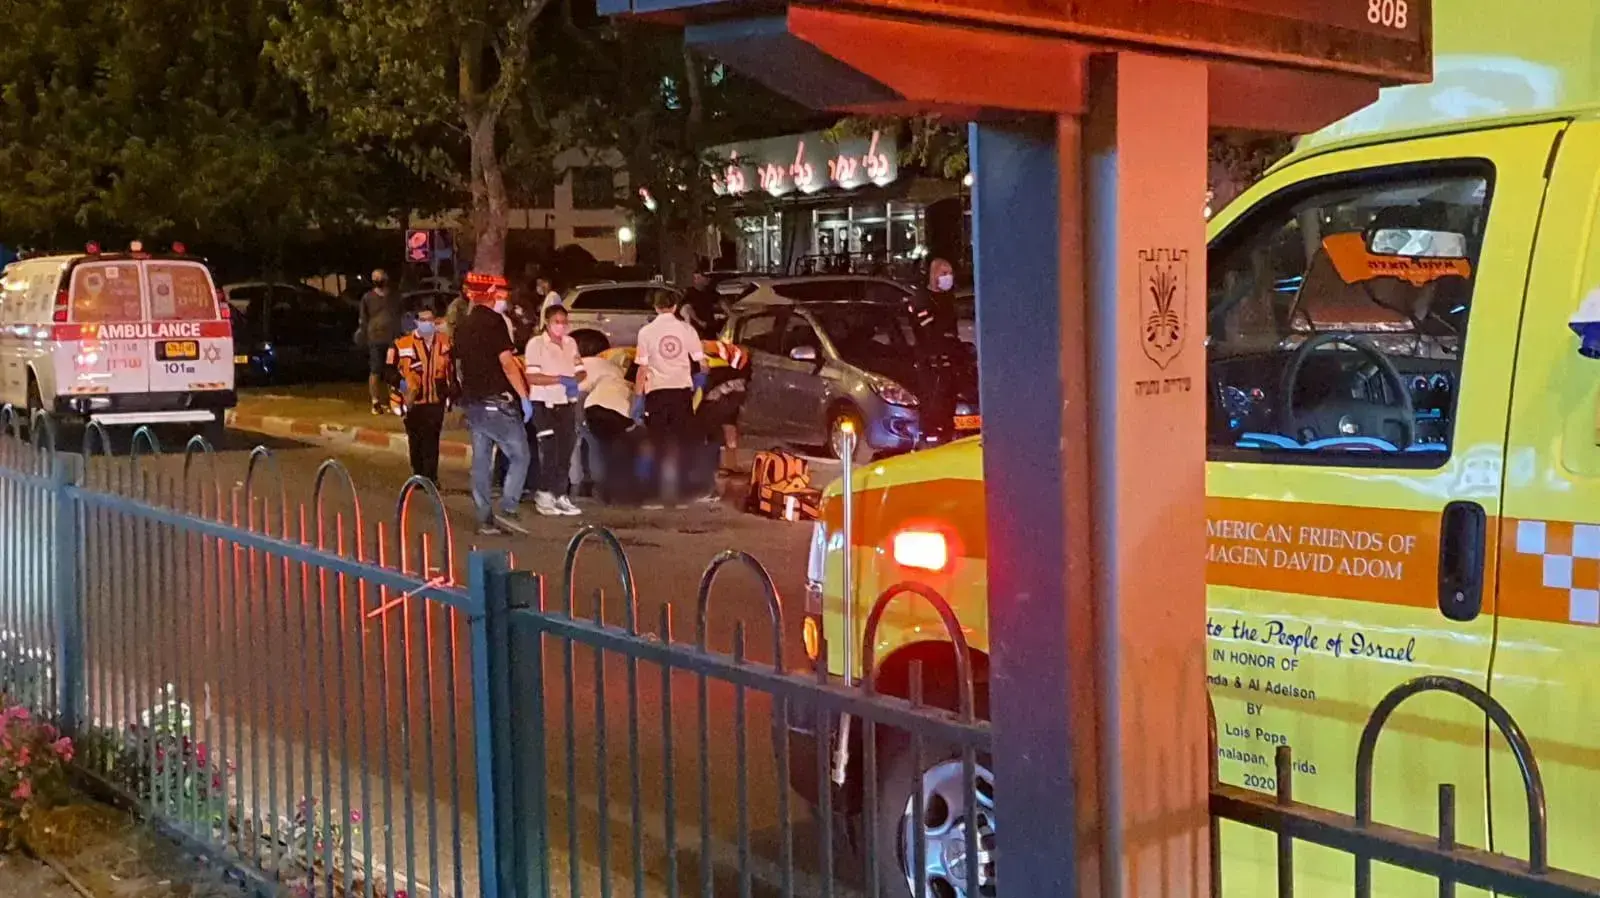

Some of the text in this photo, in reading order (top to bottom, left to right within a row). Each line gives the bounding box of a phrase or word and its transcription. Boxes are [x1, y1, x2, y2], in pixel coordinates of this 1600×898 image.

[1367, 0, 1408, 29] 80B
[97, 322, 201, 339] AMBULANCE
[164, 362, 185, 374] 101
[1206, 518, 1417, 555] MERICAN FRIENDS OF
[1273, 550, 1334, 574] DAVID
[1337, 558, 1403, 581] ADOM
[1207, 617, 1416, 663] to the People of Israel
[1213, 648, 1299, 672] IN HONOR OF
[1207, 674, 1316, 701] nda & Al Adelson
[1246, 702, 1264, 716] BY
[1225, 723, 1287, 746] Lois Pope
[1218, 747, 1317, 775] nalapan, rida
[1244, 774, 1276, 791] 2020
